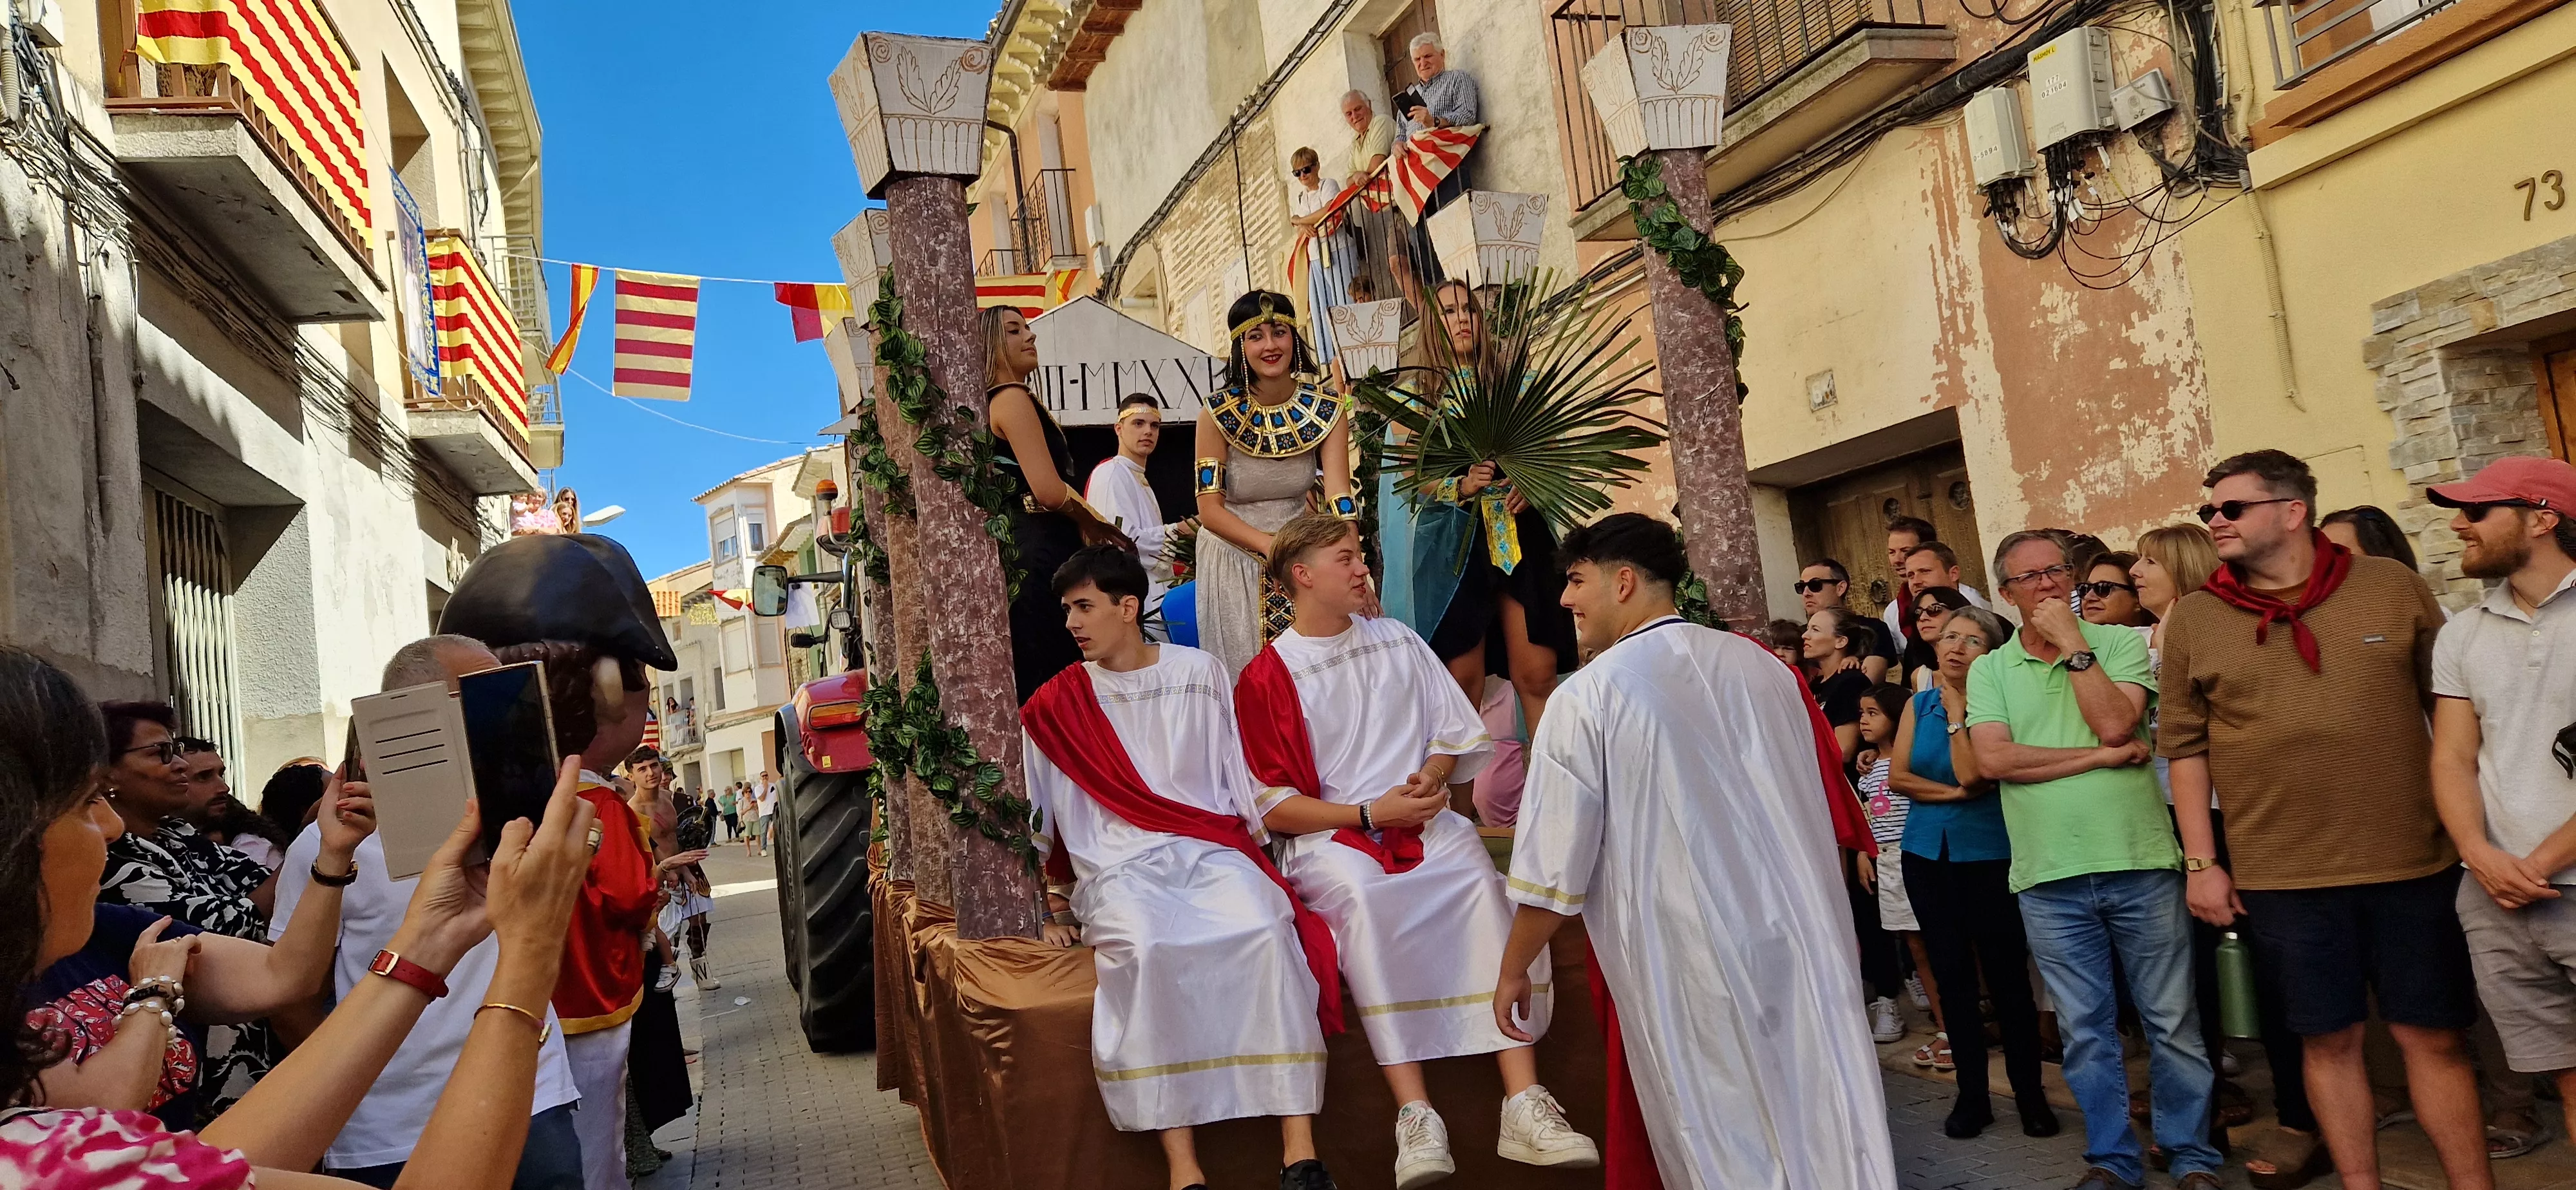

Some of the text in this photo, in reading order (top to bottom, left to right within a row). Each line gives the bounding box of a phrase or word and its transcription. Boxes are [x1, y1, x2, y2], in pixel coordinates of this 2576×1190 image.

[2047, 74, 2060, 85] 177
[2041, 81, 2067, 99] 021604
[2514, 169, 2566, 222] 73
